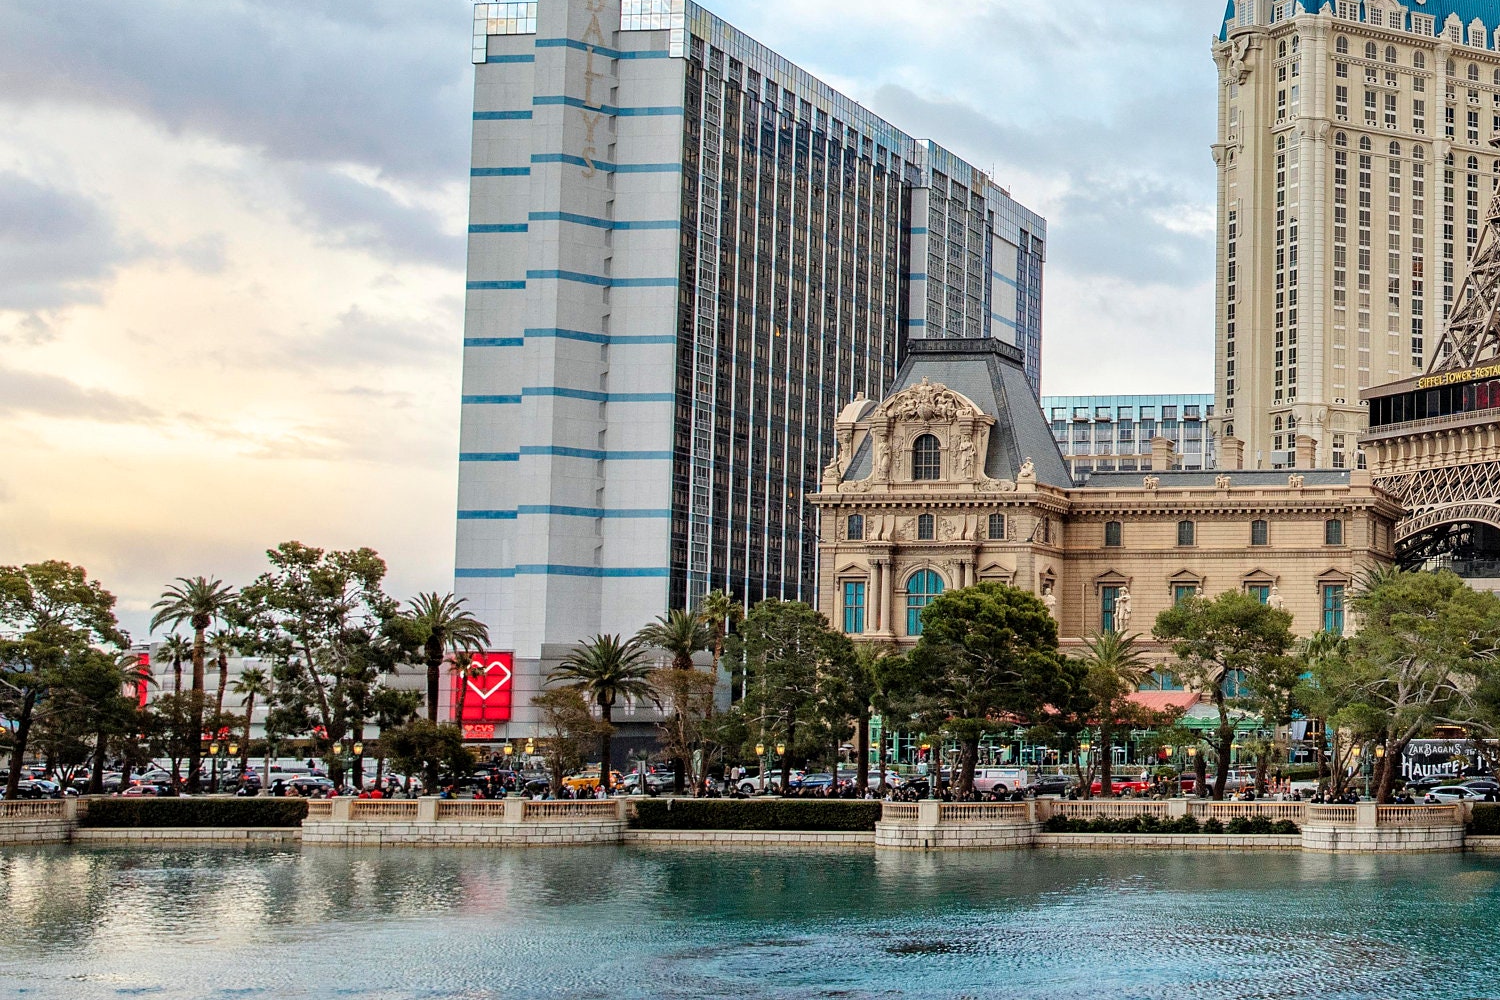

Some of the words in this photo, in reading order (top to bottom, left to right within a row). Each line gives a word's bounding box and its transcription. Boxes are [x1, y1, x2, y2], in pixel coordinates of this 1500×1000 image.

[1418, 374, 1443, 389] EIFFEL
[1445, 369, 1472, 385] TOWER
[474, 724, 494, 732] CVS
[1408, 743, 1424, 756] ZAK
